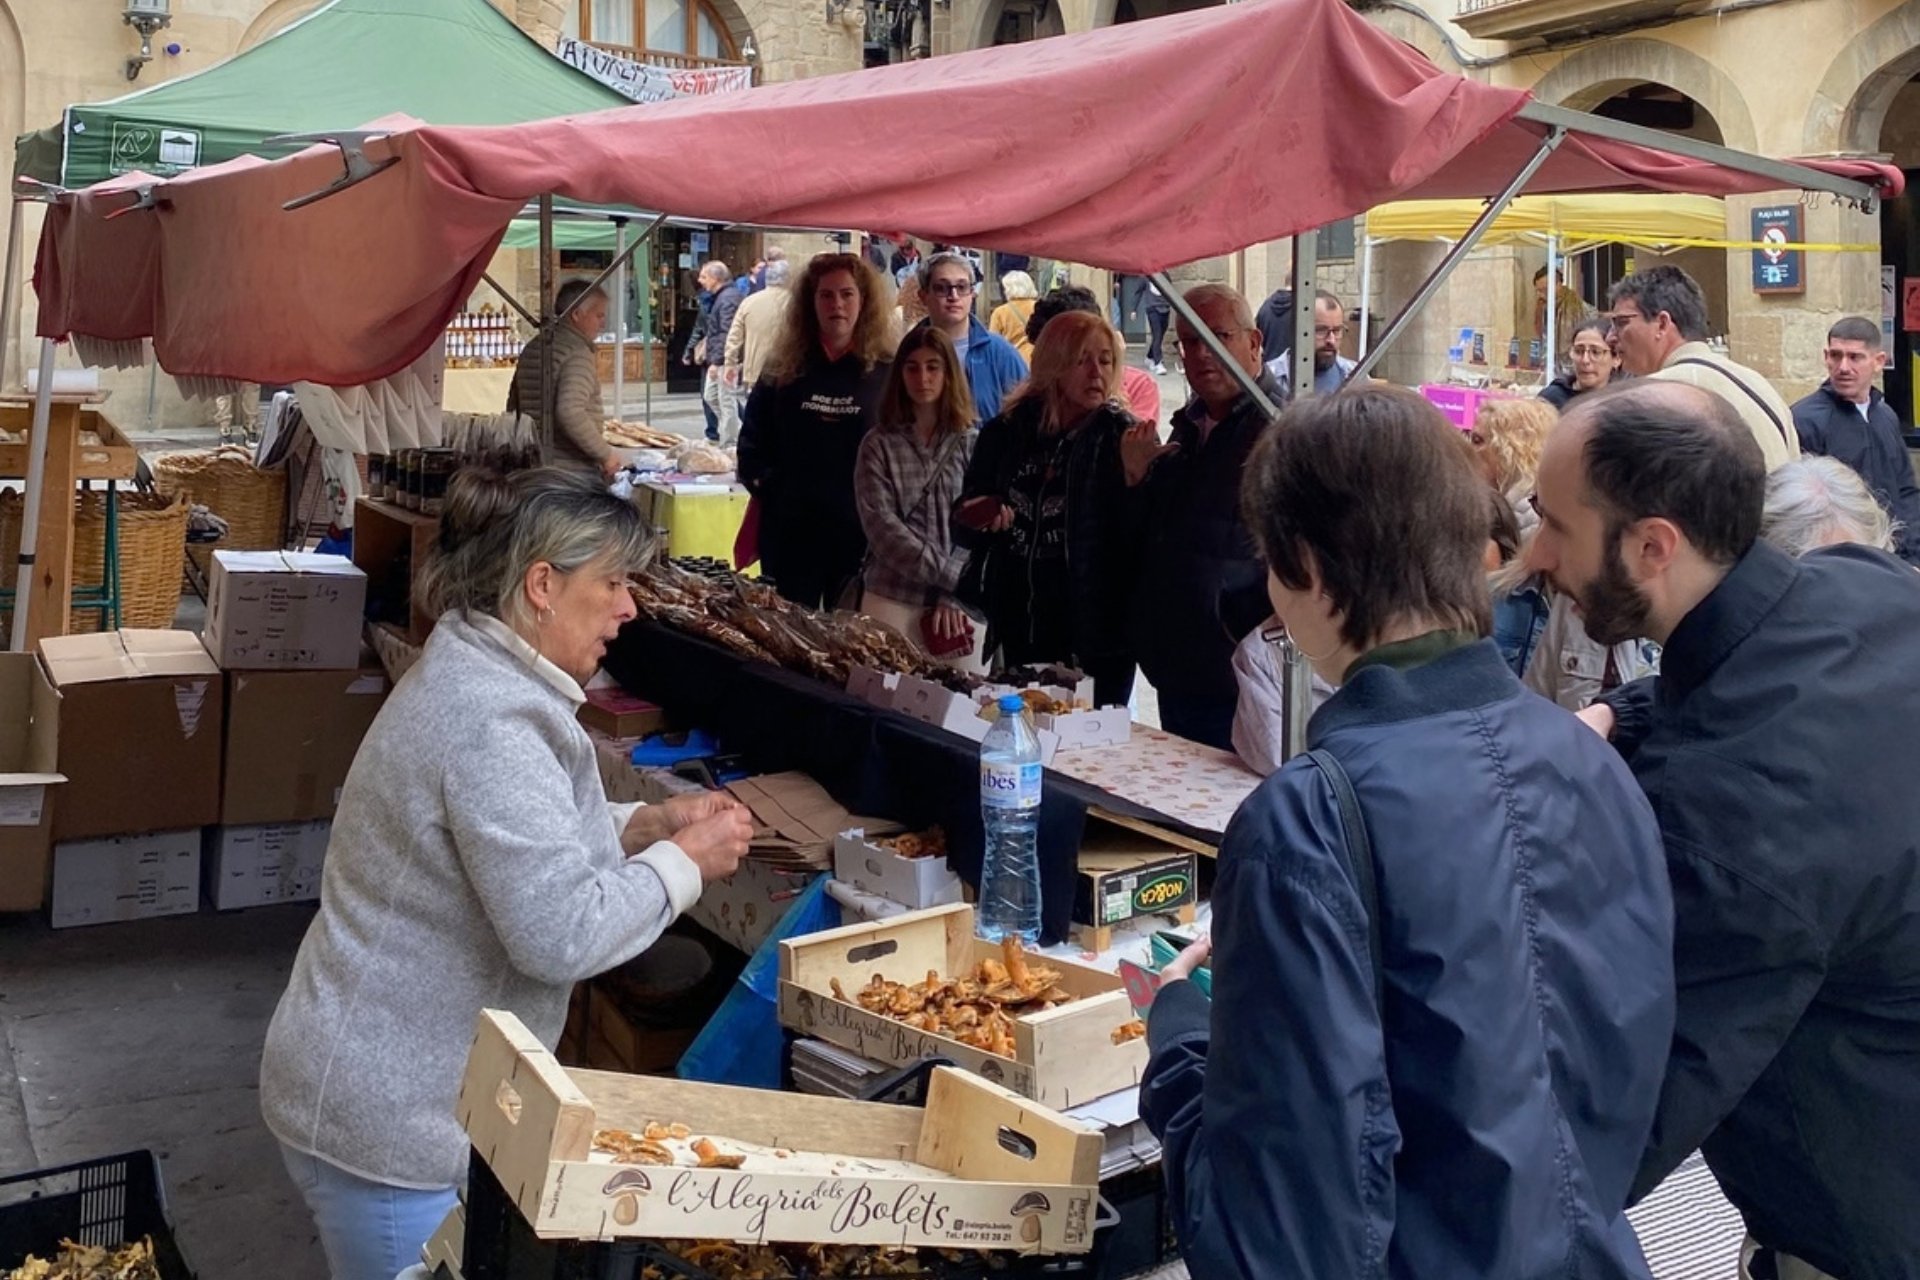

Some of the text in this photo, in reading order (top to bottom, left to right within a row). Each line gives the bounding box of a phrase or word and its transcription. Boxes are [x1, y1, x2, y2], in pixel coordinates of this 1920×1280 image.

[982, 768, 1016, 791] ibes
[667, 1171, 951, 1236] l'Alegria dels Bolets
